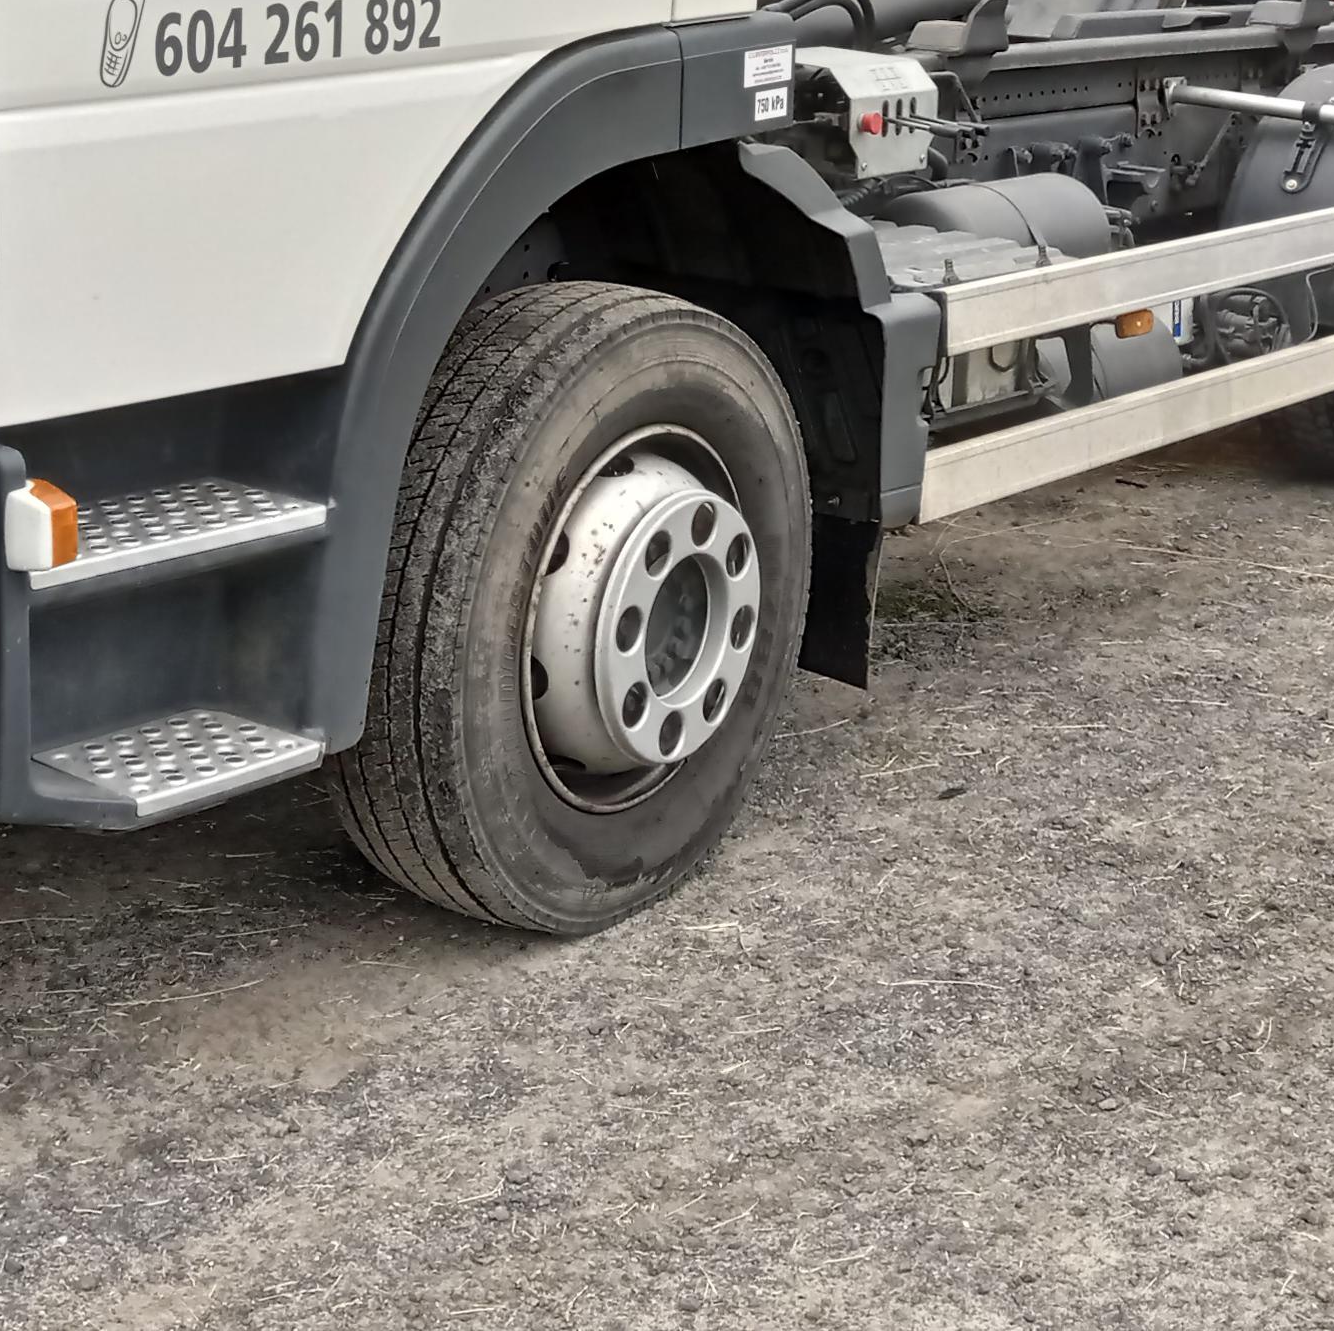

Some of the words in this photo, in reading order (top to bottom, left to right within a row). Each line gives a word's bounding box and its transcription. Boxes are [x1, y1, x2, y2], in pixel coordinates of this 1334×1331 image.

[154, 8, 247, 77] 604
[264, 0, 343, 66] 261
[757, 97, 770, 114] 750
[771, 95, 785, 111] kPa
